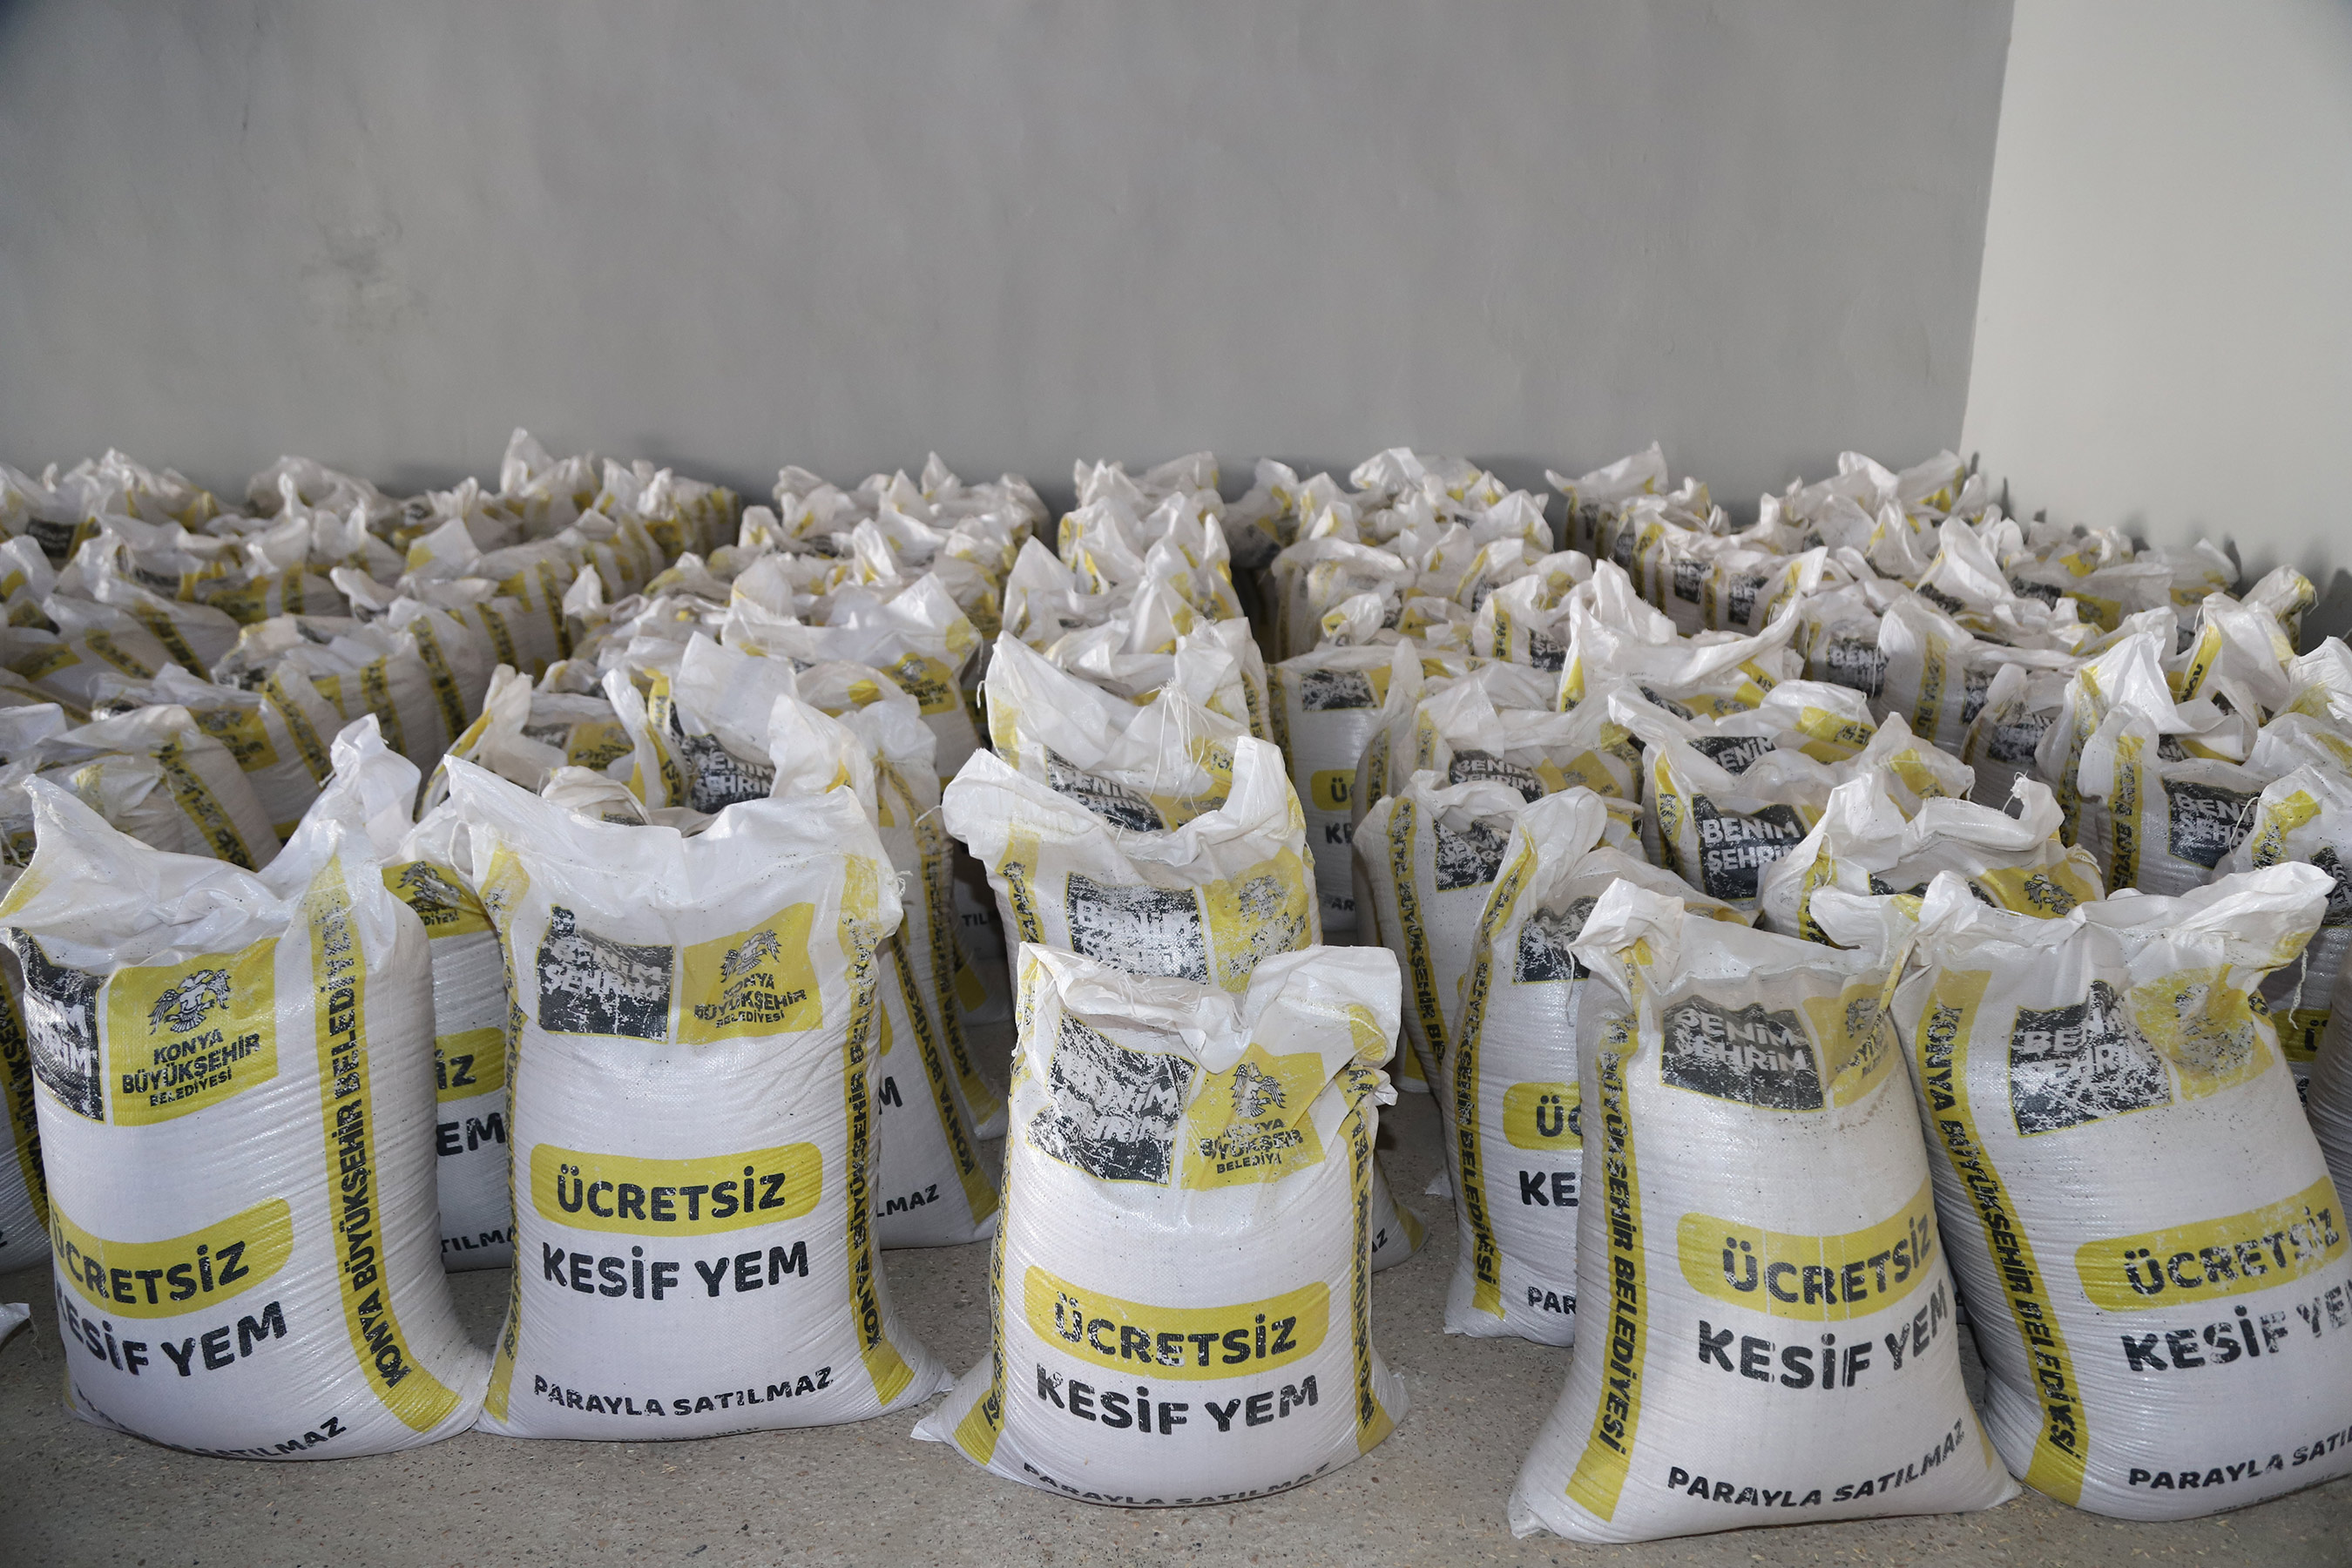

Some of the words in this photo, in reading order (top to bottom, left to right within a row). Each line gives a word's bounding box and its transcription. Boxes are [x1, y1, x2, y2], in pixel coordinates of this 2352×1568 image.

[121, 1033, 261, 1095] BÜYÜKŞEHİR
[153, 1028, 224, 1065] KONYA
[150, 1066, 233, 1107] BELEDİYESİ
[938, 1083, 976, 1175] KONYA
[332, 1099, 378, 1292] BÜYÜKŞEHİR
[558, 1164, 787, 1222] ÜCRETSİZ
[50, 1205, 250, 1306] ÜCRETSİZ
[542, 1241, 680, 1301] KESİF
[694, 1240, 809, 1298] YEM
[1722, 1213, 1932, 1306] ÜCRETSİZ
[160, 1301, 288, 1377] YEM
[358, 1288, 412, 1389] KONYA
[1053, 1290, 1298, 1368] ÜCRETSİZ
[1598, 1254, 1638, 1456] BELEDİYESİ
[1698, 1319, 1873, 1390] KESİF
[1883, 1278, 1949, 1371] YEM
[2119, 1303, 2288, 1373] KESİF
[534, 1374, 666, 1416] PARAYLA
[673, 1366, 835, 1416] SATILMAZ
[1036, 1361, 1189, 1436] KESİF
[1204, 1374, 1320, 1433] YEM
[1666, 1465, 1822, 1508] PARAYLA
[1831, 1417, 1965, 1504] SATILMAZ
[2128, 1452, 2284, 1490] PARAYLA
